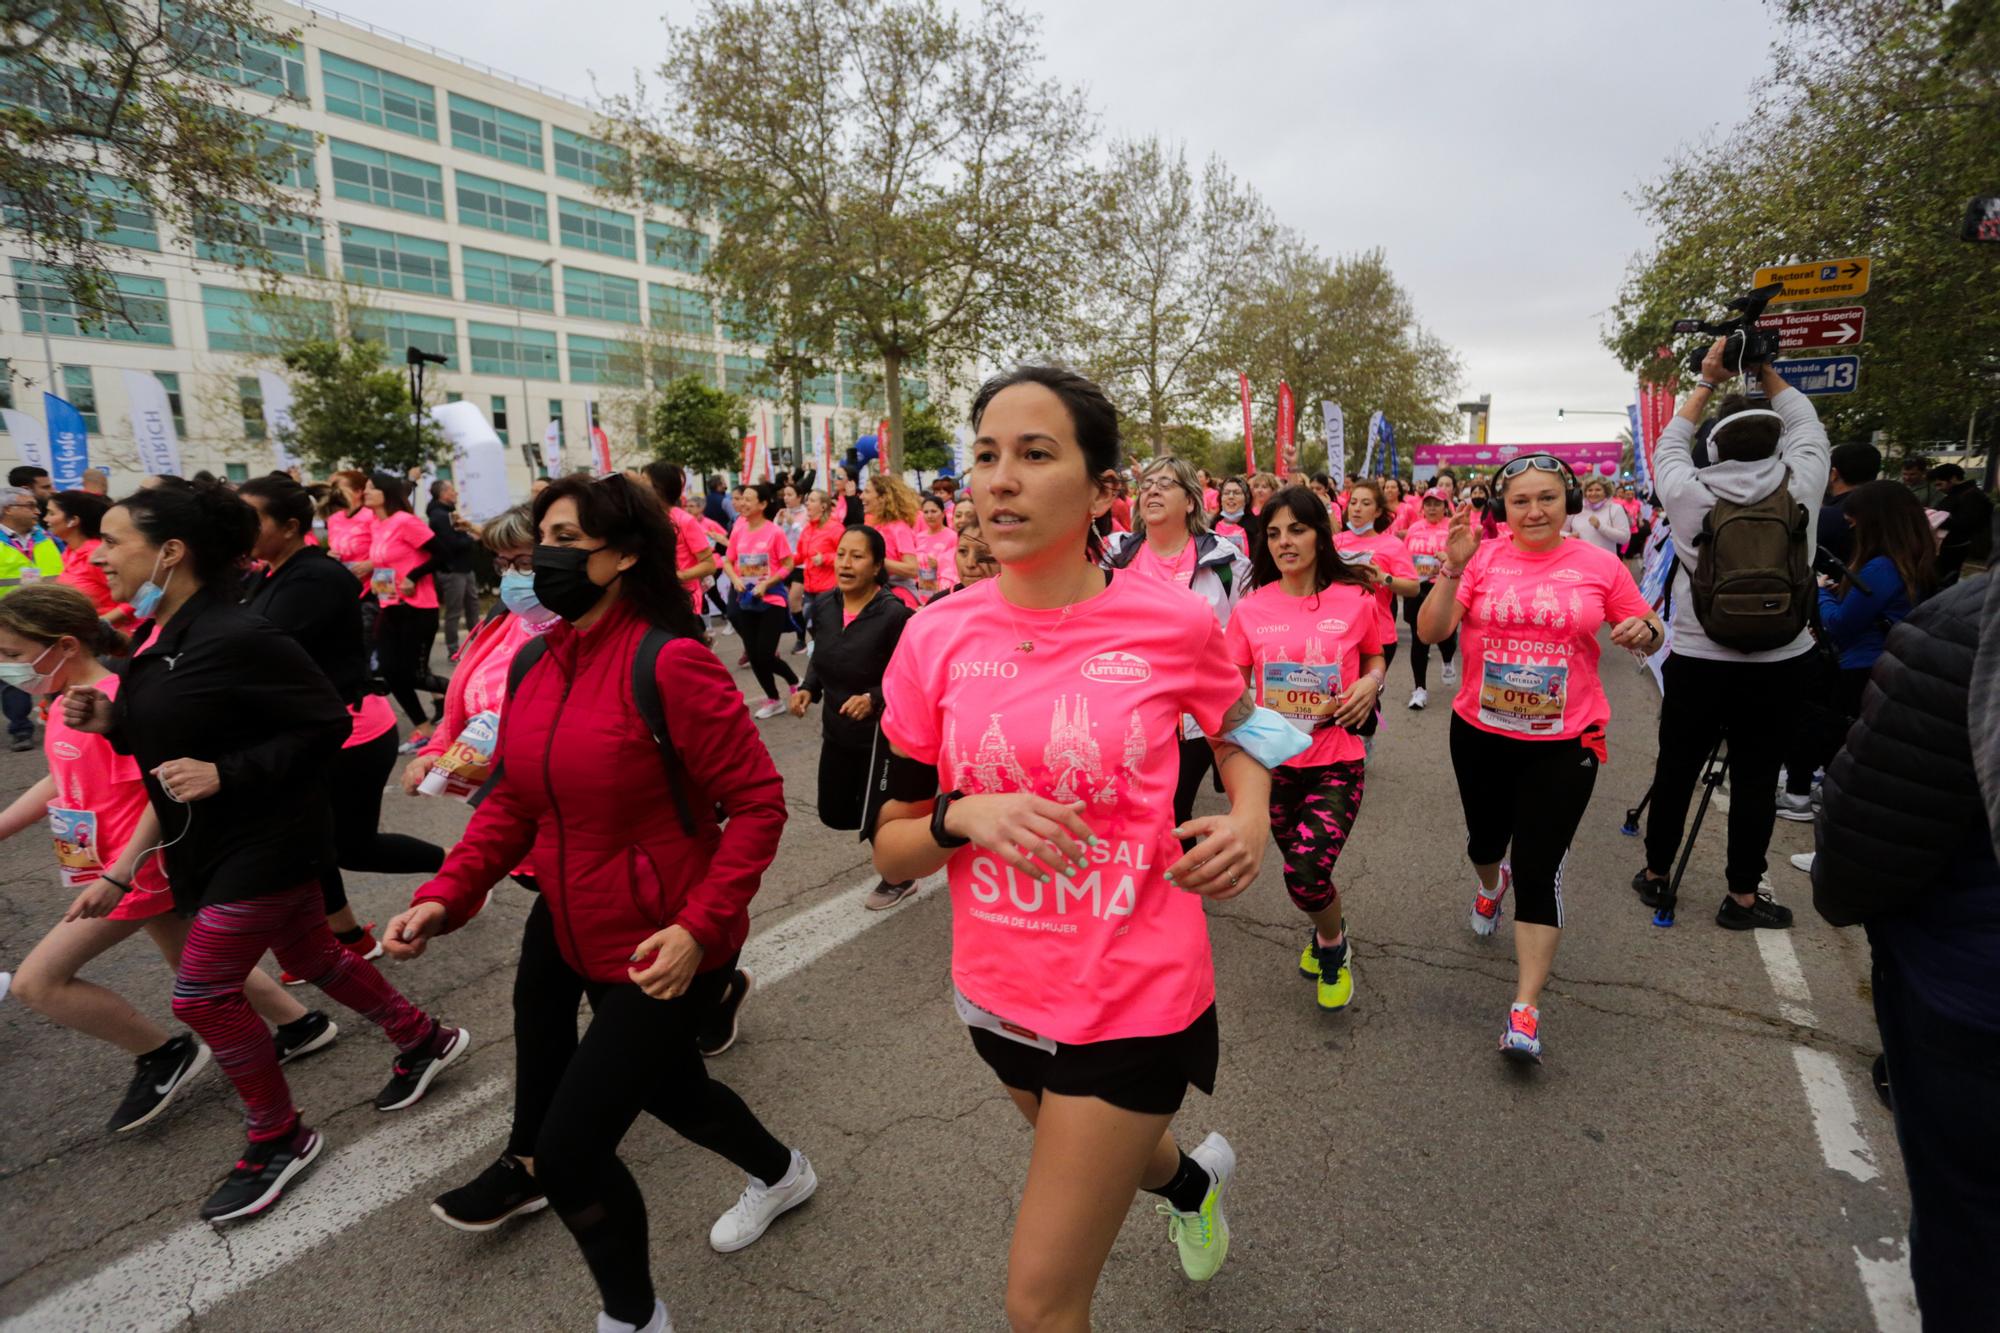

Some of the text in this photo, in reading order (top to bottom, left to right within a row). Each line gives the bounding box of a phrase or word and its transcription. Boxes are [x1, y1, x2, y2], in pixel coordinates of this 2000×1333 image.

[1770, 270, 1815, 282] Rectorat
[1779, 283, 1853, 297] Altres centres
[1822, 311, 1862, 322] Superior
[1779, 327, 1809, 337] inyeria
[1779, 338, 1804, 347] àtica
[1784, 364, 1820, 374] trobada
[1823, 363, 1855, 388] 13
[1256, 624, 1290, 635] OYSHO
[1482, 638, 1575, 657] TU DORSAL
[1088, 662, 1147, 678] ASTURIANA
[1287, 690, 1320, 705] 016
[1504, 690, 1540, 706] 016
[451, 741, 477, 762] 16
[970, 856, 1136, 921] SUMA
[968, 908, 1078, 934] CARRERA DE LA MUJER
